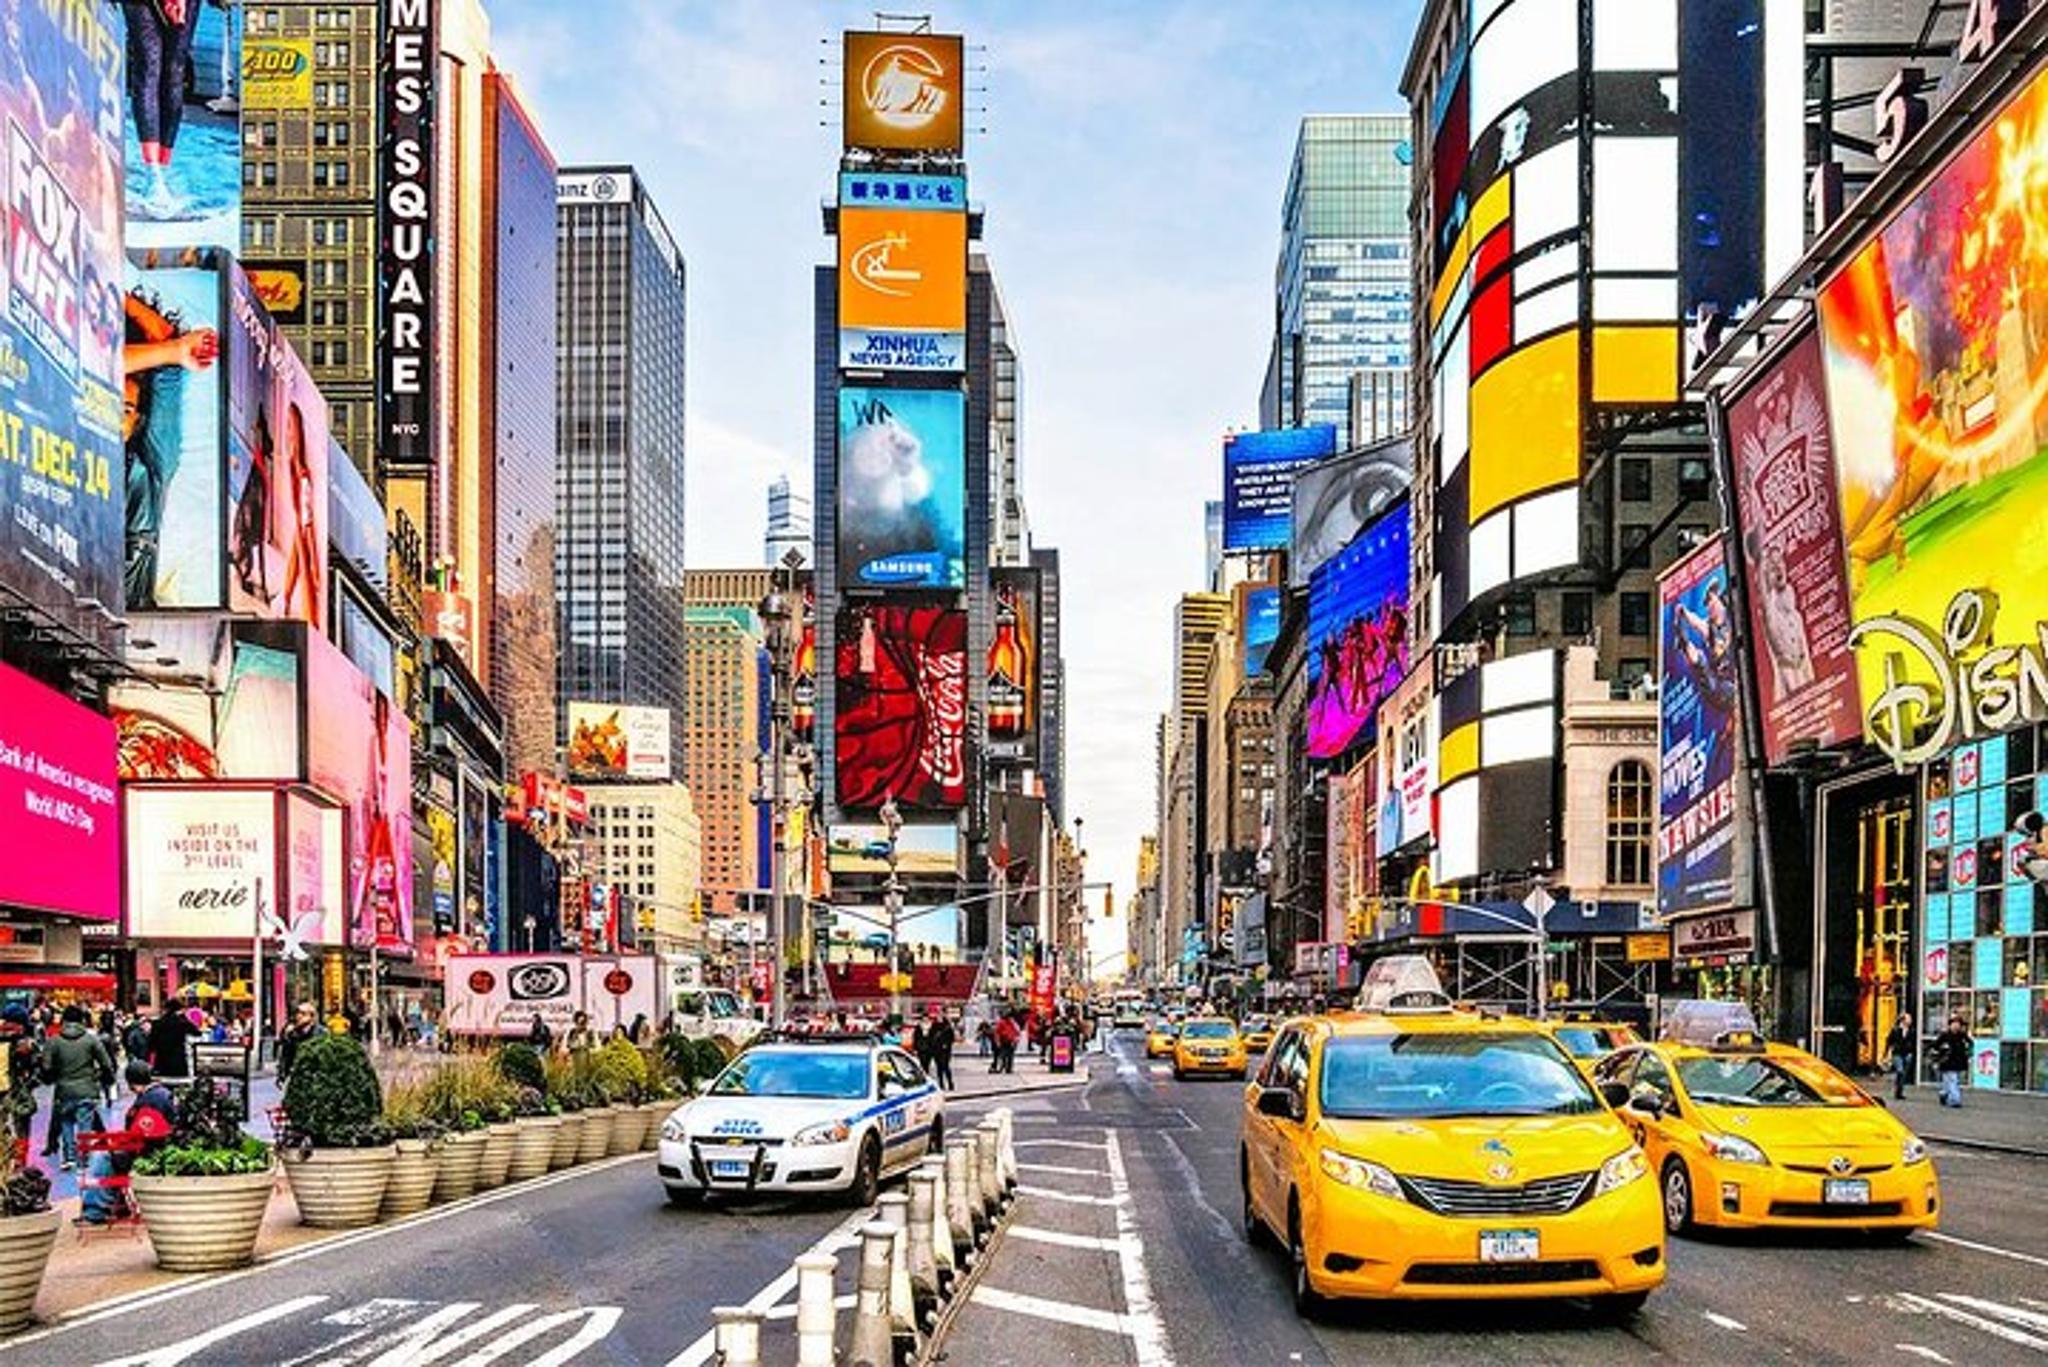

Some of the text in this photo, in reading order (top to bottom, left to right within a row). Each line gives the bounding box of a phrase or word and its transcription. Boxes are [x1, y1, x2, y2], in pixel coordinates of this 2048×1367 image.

[11, 120, 80, 284] FOX
[389, 140, 427, 394] SQUARE
[14, 224, 79, 346] UFC
[866, 334, 940, 353] XINHUA
[849, 352, 956, 368] NEWS AGENCY
[391, 424, 420, 436] NYC
[31, 424, 81, 489] DEC.
[84, 449, 110, 501] 14
[869, 560, 934, 576] SAMSUNG
[185, 823, 241, 837] VISIT US
[168, 839, 258, 853] INSIDE ON THE
[207, 855, 243, 869] LEVEL
[179, 879, 249, 910] aerie
[711, 1126, 764, 1135] POLICE
